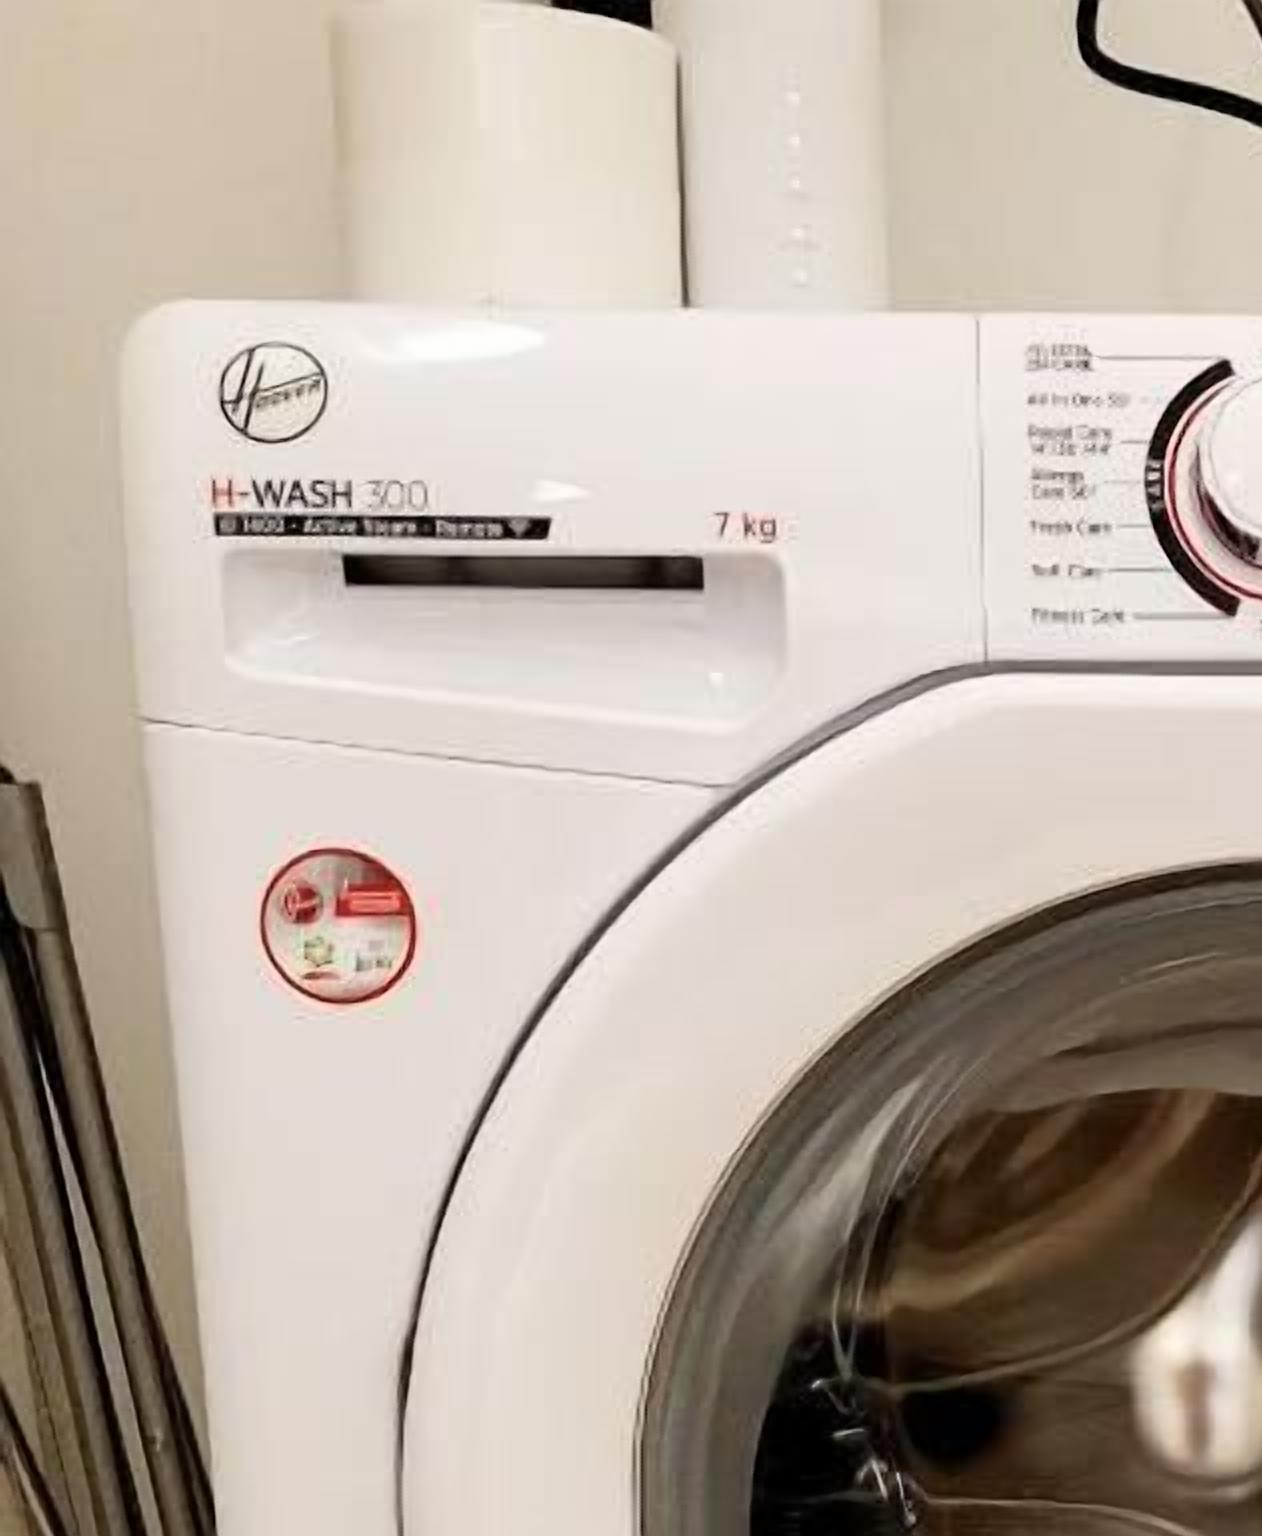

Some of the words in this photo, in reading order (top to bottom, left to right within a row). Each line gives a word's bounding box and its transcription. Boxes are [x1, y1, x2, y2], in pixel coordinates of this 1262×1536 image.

[211, 478, 353, 510] H-WASH
[366, 479, 429, 510] 300
[714, 512, 727, 536] 7
[741, 512, 777, 543] kg
